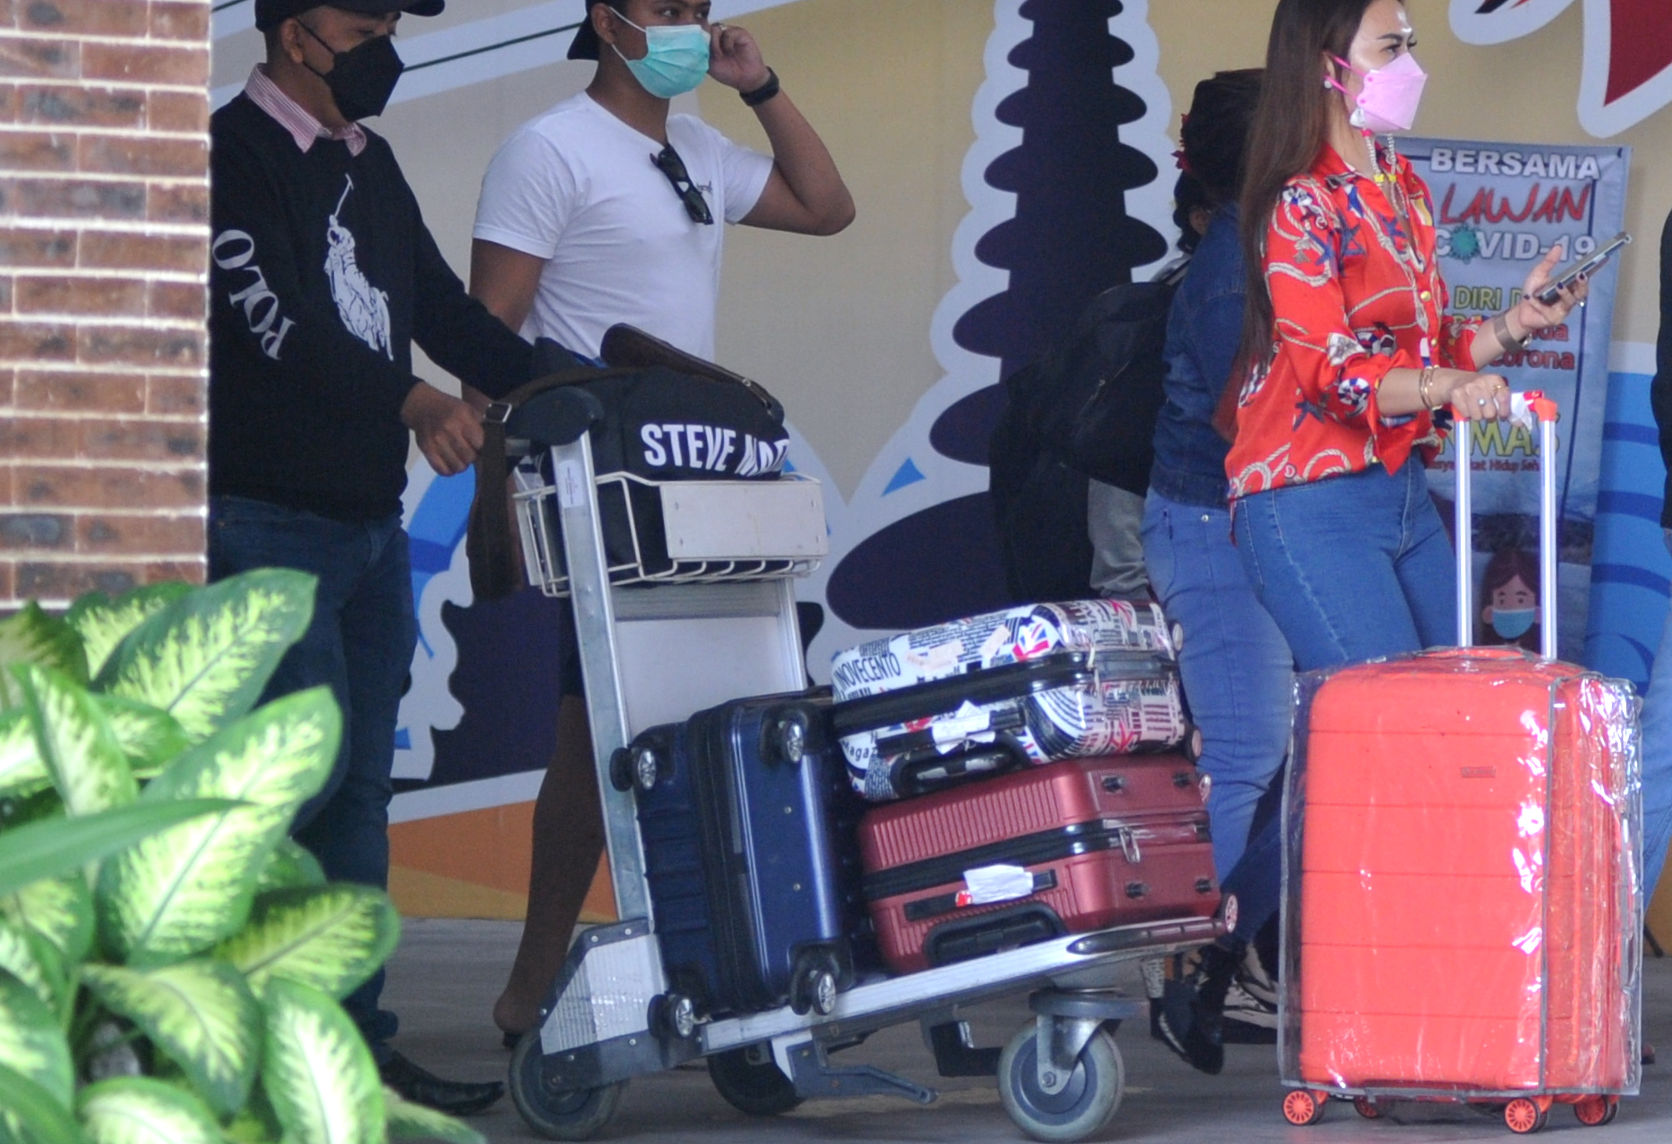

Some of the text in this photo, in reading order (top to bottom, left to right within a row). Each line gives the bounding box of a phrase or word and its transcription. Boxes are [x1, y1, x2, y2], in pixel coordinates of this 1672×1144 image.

[1430, 147, 1600, 180] BERSAMA
[1439, 182, 1591, 224] LAWAN
[211, 229, 296, 361] POLO
[1454, 285, 1502, 311] DIRI
[641, 423, 736, 471] STEVE
